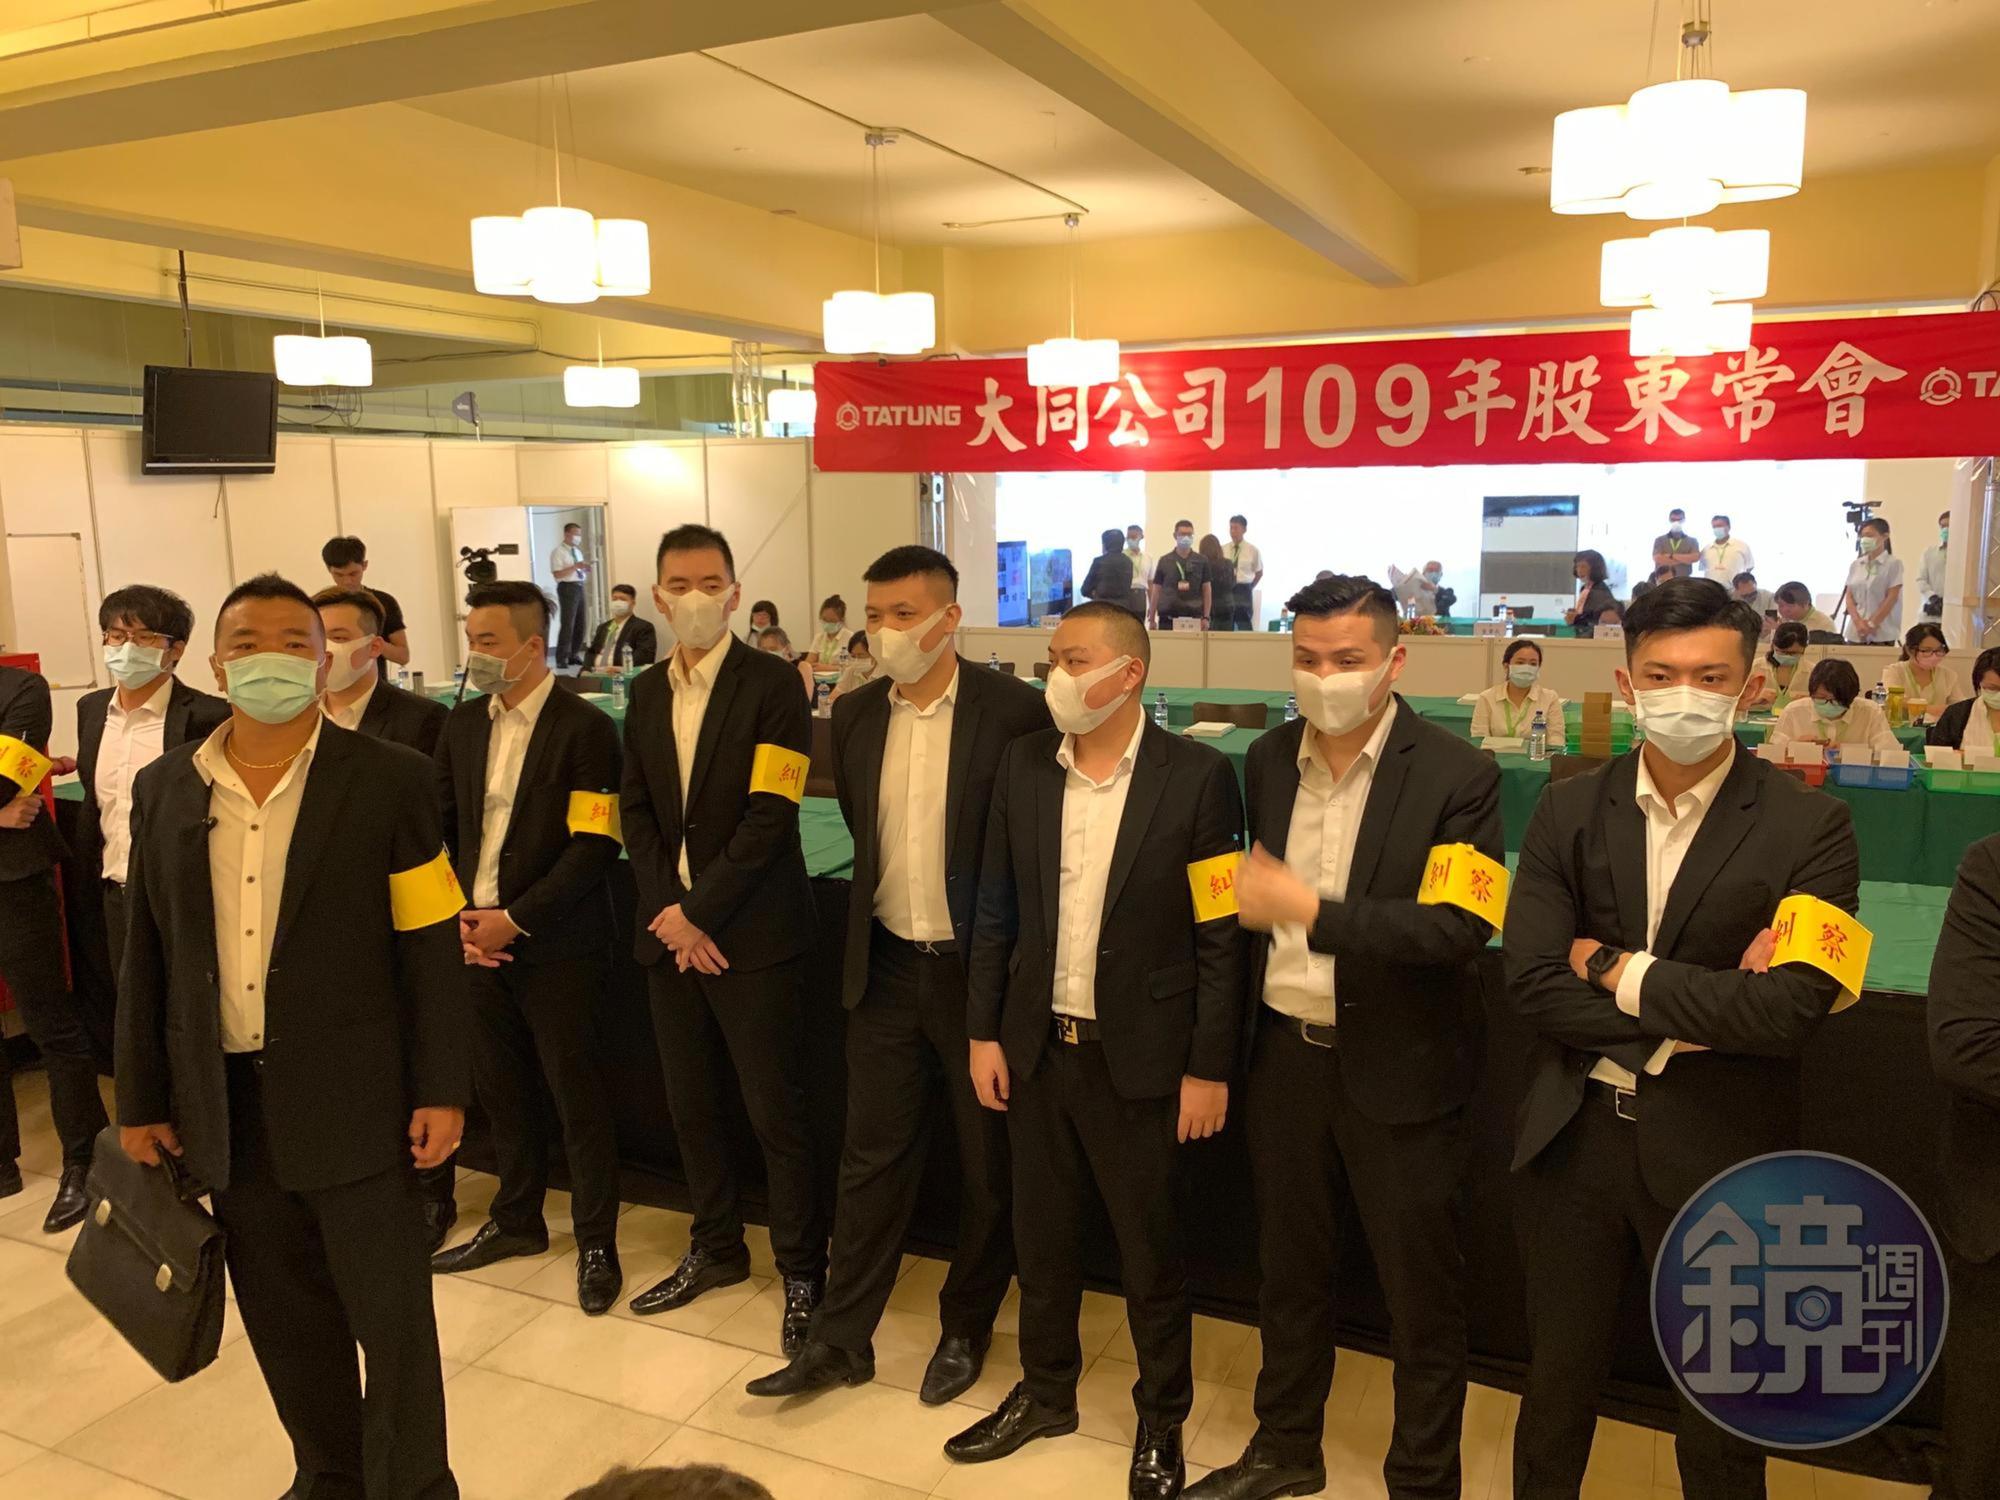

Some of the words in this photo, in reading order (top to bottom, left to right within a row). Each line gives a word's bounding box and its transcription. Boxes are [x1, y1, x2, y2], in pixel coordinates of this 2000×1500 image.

[863, 404, 962, 428] TATUNG
[966, 340, 1908, 453] 大同公司109年股東常會
